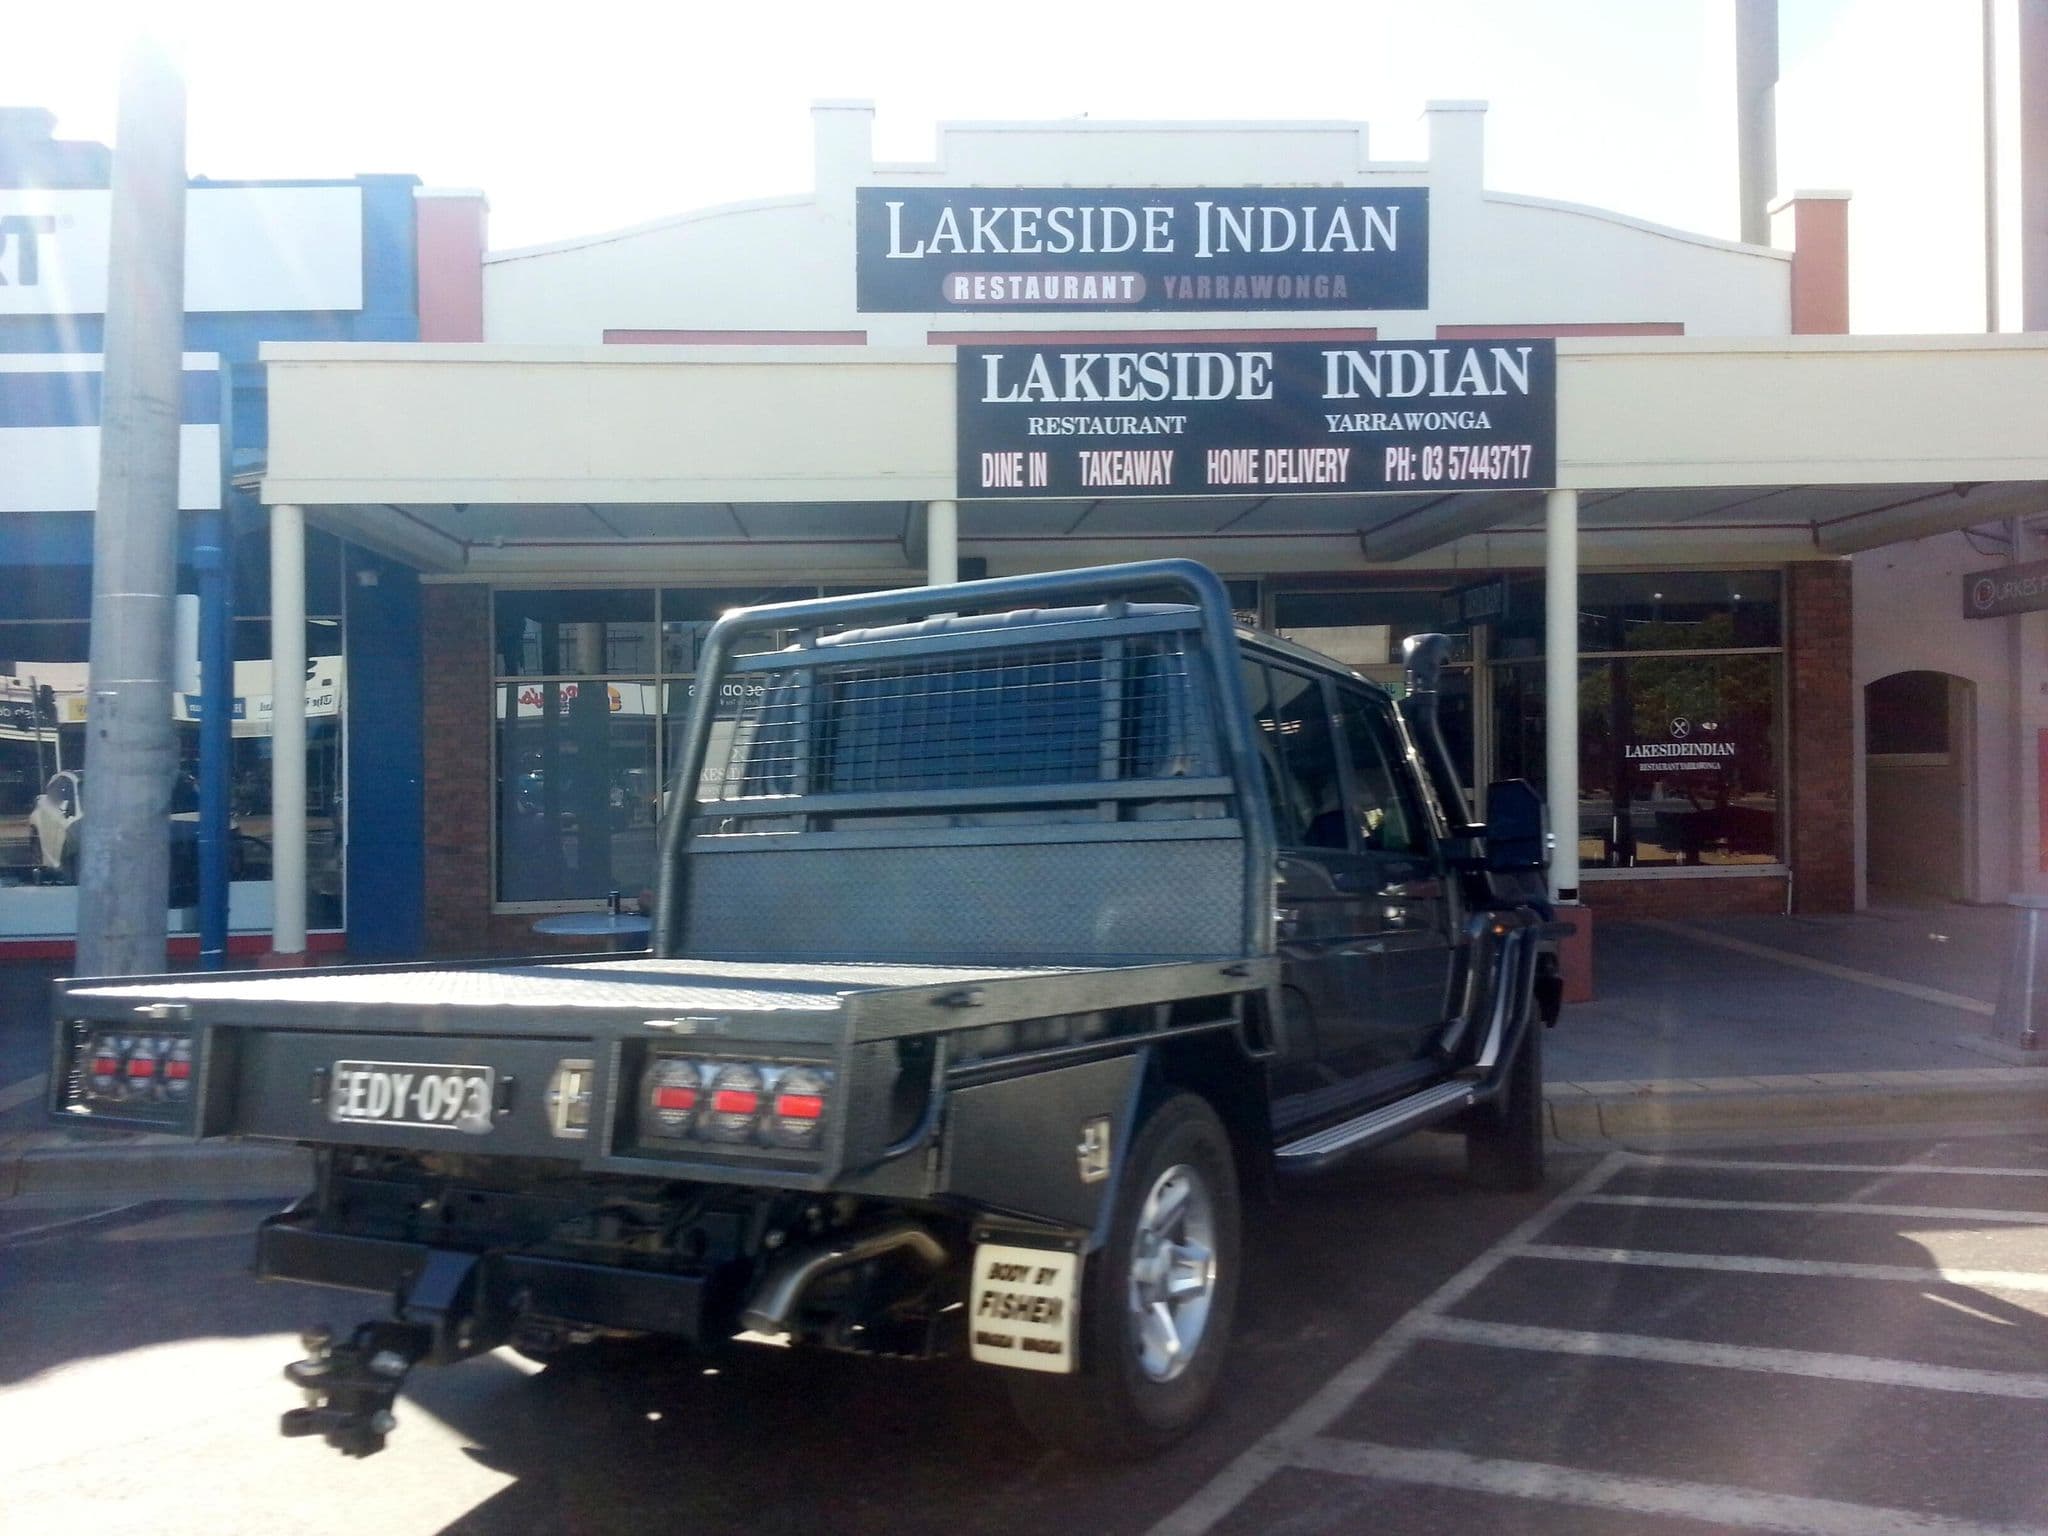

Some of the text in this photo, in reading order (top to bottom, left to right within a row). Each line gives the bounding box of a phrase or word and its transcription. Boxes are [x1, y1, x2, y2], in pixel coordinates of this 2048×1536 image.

[885, 201, 1400, 259] LAKESIDE INDIAN
[954, 274, 1348, 300] RESTAURANT YARRAWONGA
[981, 346, 1533, 403] LAKESIDE INDIAN
[1028, 410, 1492, 436] RESTAURANT YARRAWONGA
[981, 444, 1532, 488] DINE IN TAKEAWAY HOME DELIVERY PH: 03 57443717
